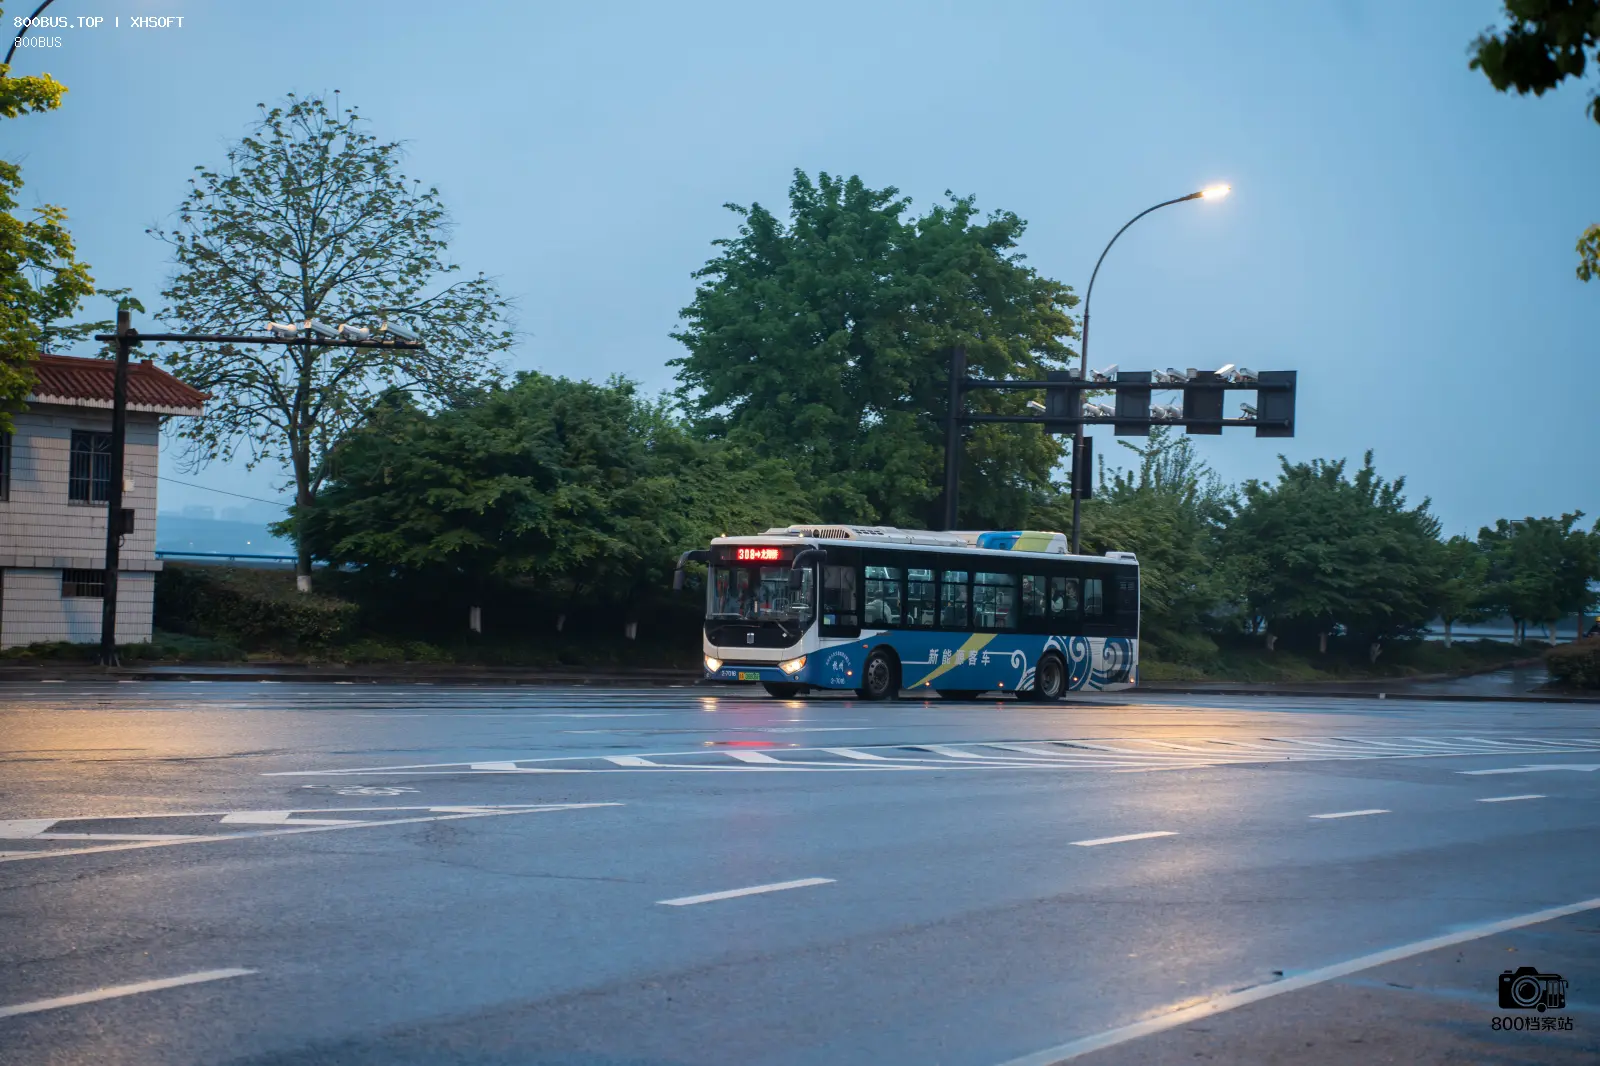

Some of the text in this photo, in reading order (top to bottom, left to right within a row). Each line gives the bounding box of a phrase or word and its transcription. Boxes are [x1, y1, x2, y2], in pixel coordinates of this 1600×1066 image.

[739, 548, 755, 560] 308
[928, 647, 991, 667] 新能源客车
